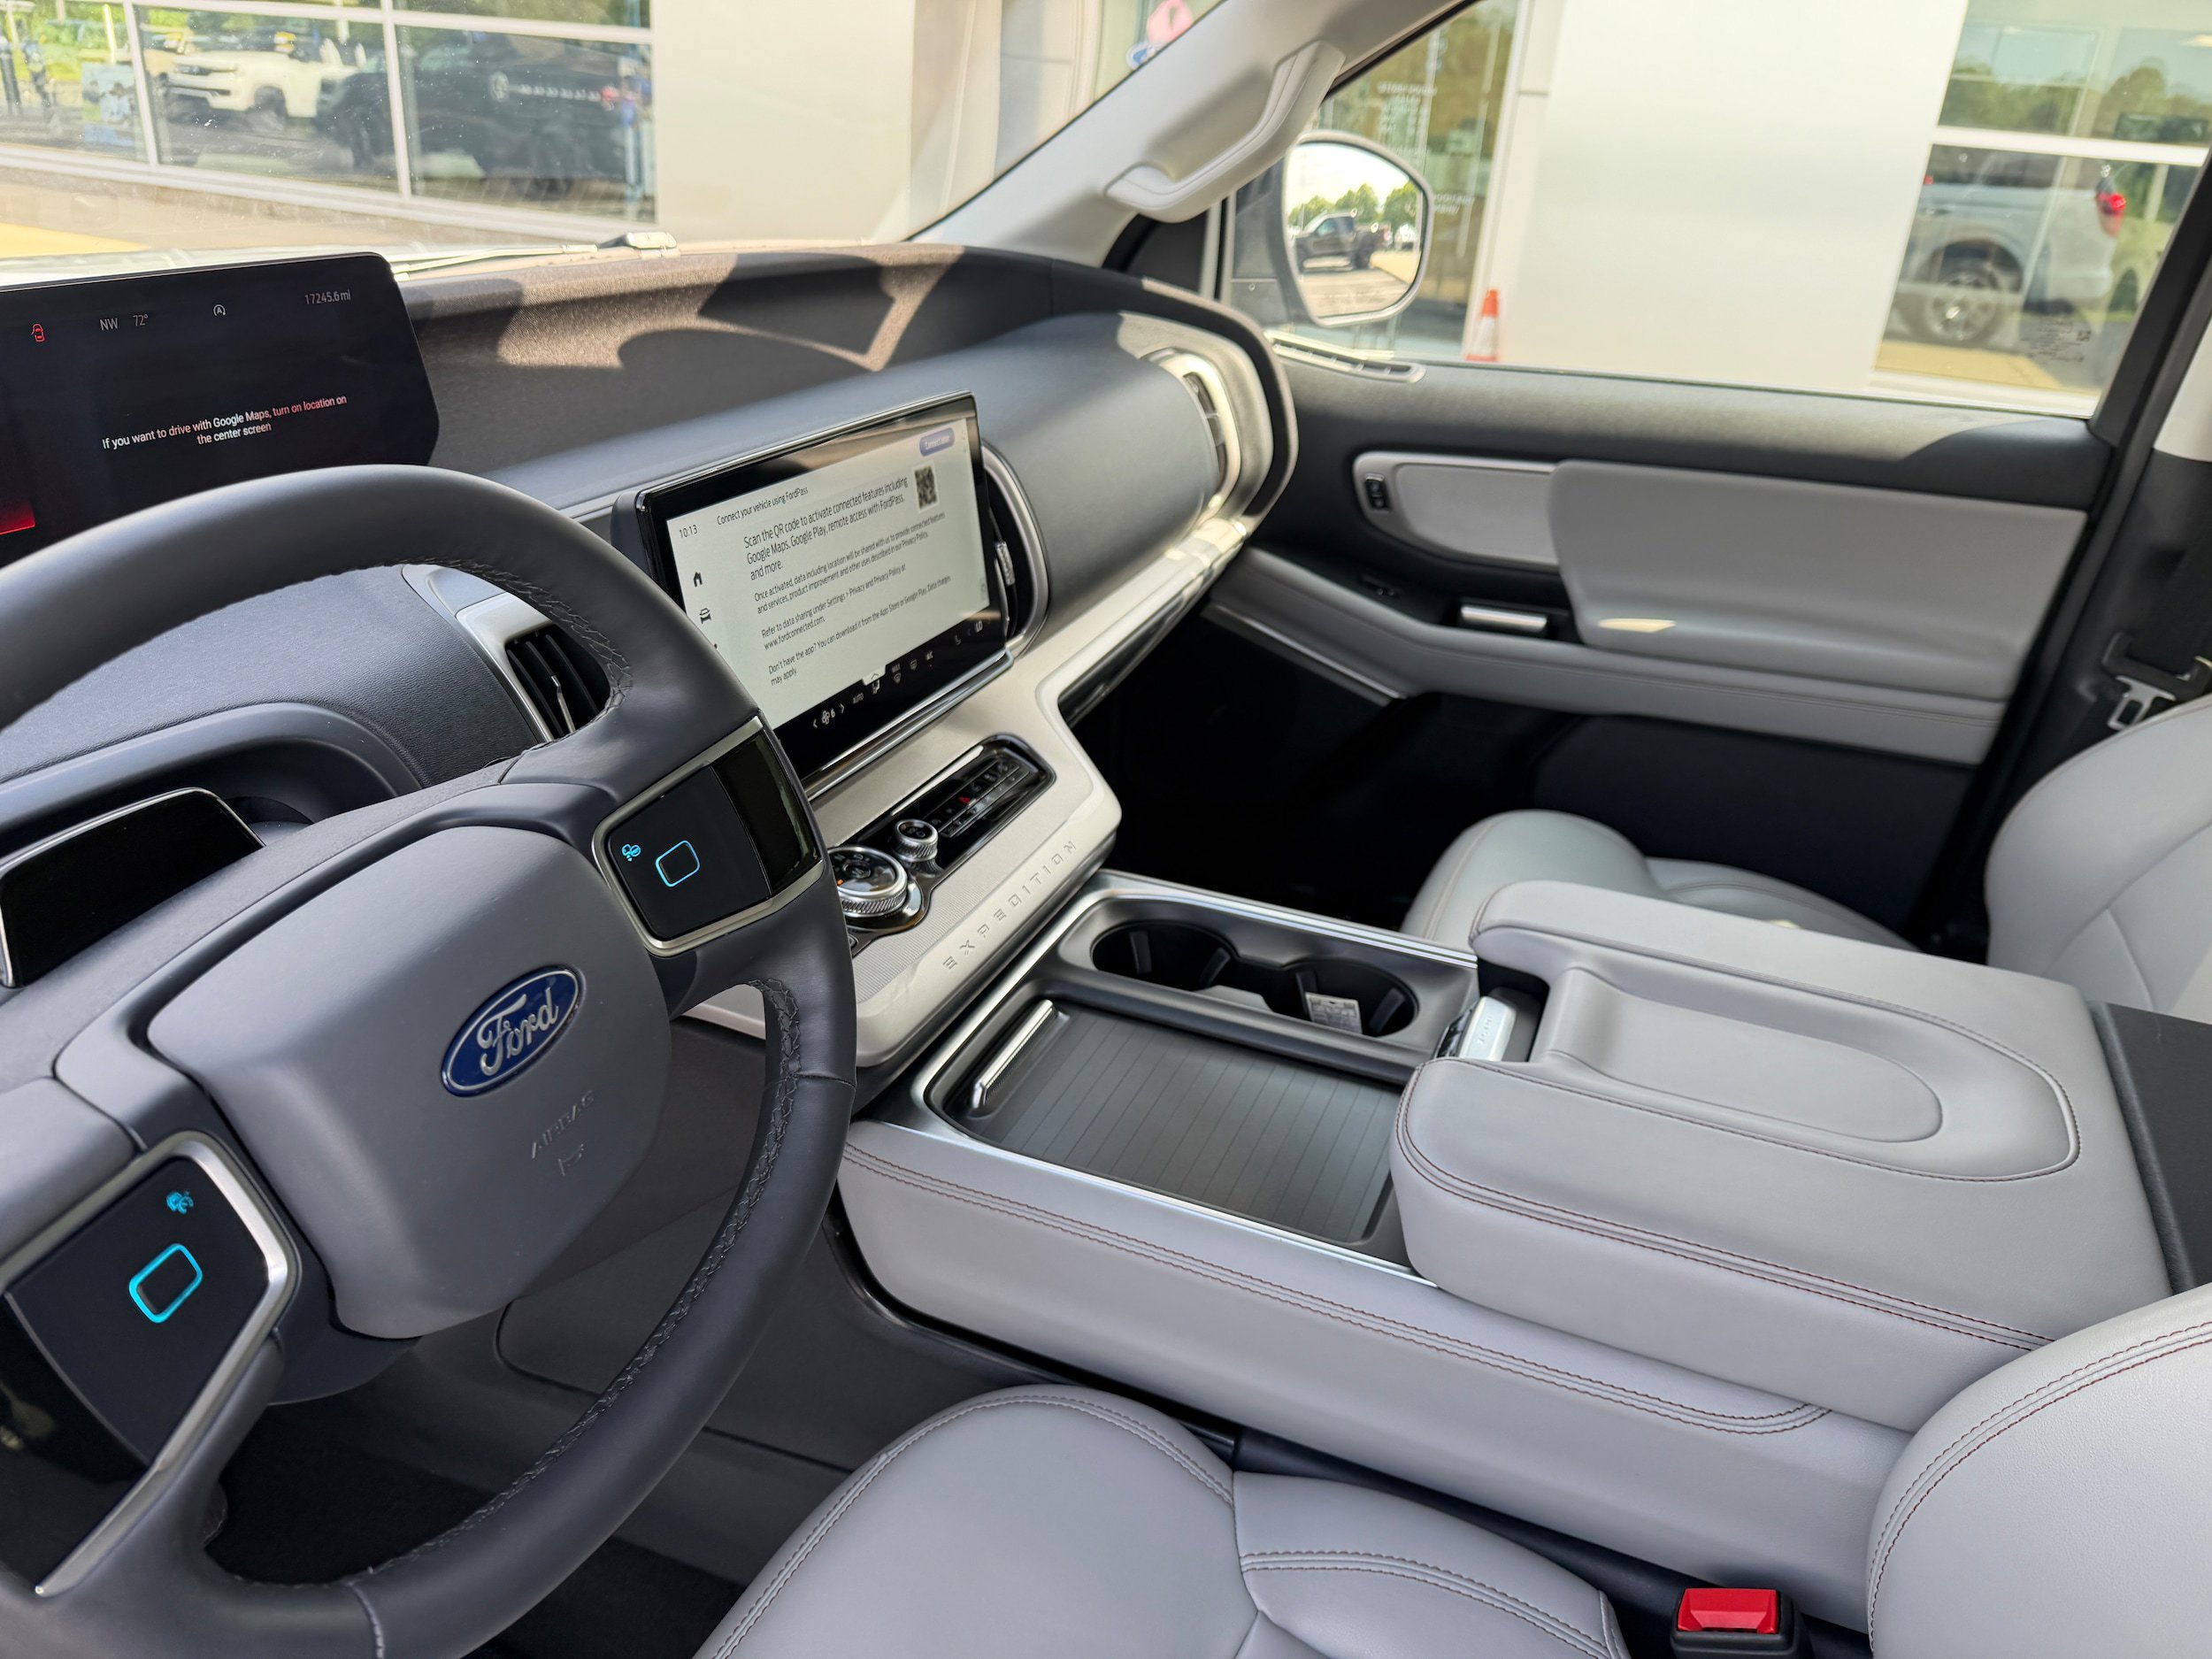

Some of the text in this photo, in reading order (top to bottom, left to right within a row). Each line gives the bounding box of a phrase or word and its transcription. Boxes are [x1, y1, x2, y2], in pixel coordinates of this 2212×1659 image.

[100, 313, 149, 331] NW 72°
[304, 289, 352, 305] 17245.6 mi
[102, 395, 347, 450] If you want to drive with Google Maps, turn on location on
[197, 423, 272, 445] the center screen
[679, 524, 698, 538] 10:13
[716, 487, 808, 525] Connect your vehicle using FordPass
[743, 477, 908, 548] Scan the QR code to activate connected features including
[747, 547, 770, 564] Google
[790, 530, 812, 546] Google
[827, 516, 848, 531] remote
[849, 509, 867, 523] access
[867, 502, 880, 515] with
[750, 560, 783, 580] and more.
[754, 590, 768, 602] Once
[793, 574, 806, 584] data
[805, 564, 827, 579] including
[826, 556, 846, 569] location
[854, 549, 860, 558] be
[860, 541, 875, 555] shared
[757, 602, 768, 614] and
[789, 584, 808, 600] product
[808, 571, 839, 590] improvement
[839, 565, 849, 577] and
[848, 561, 860, 572] other
[860, 557, 871, 567] uses
[870, 546, 891, 562] described
[901, 536, 916, 547] Privacy
[761, 626, 775, 638] Refer
[776, 623, 782, 631] to
[782, 617, 795, 628] data
[795, 608, 813, 622] sharing
[812, 602, 826, 614] under
[826, 593, 845, 607] Settings
[849, 584, 865, 596] Privacy
[865, 578, 874, 589] and
[873, 572, 889, 583] Privacy
[888, 567, 901, 577] Policy
[900, 563, 906, 572] at
[768, 661, 783, 674] Don't
[782, 655, 795, 666] have
[795, 651, 804, 660] the
[804, 642, 816, 656] app?
[817, 639, 827, 648] You
[826, 634, 835, 644] can
[835, 622, 858, 639] download
[857, 620, 862, 628] it
[861, 616, 872, 626] from
[879, 607, 889, 616] App
[771, 676, 782, 685] may
[853, 692, 864, 704] AUTO
[831, 708, 836, 718] 6
[942, 841, 1077, 970] EXPEDITION
[477, 987, 559, 1076] Ford
[531, 1090, 594, 1159] AIRBAG
